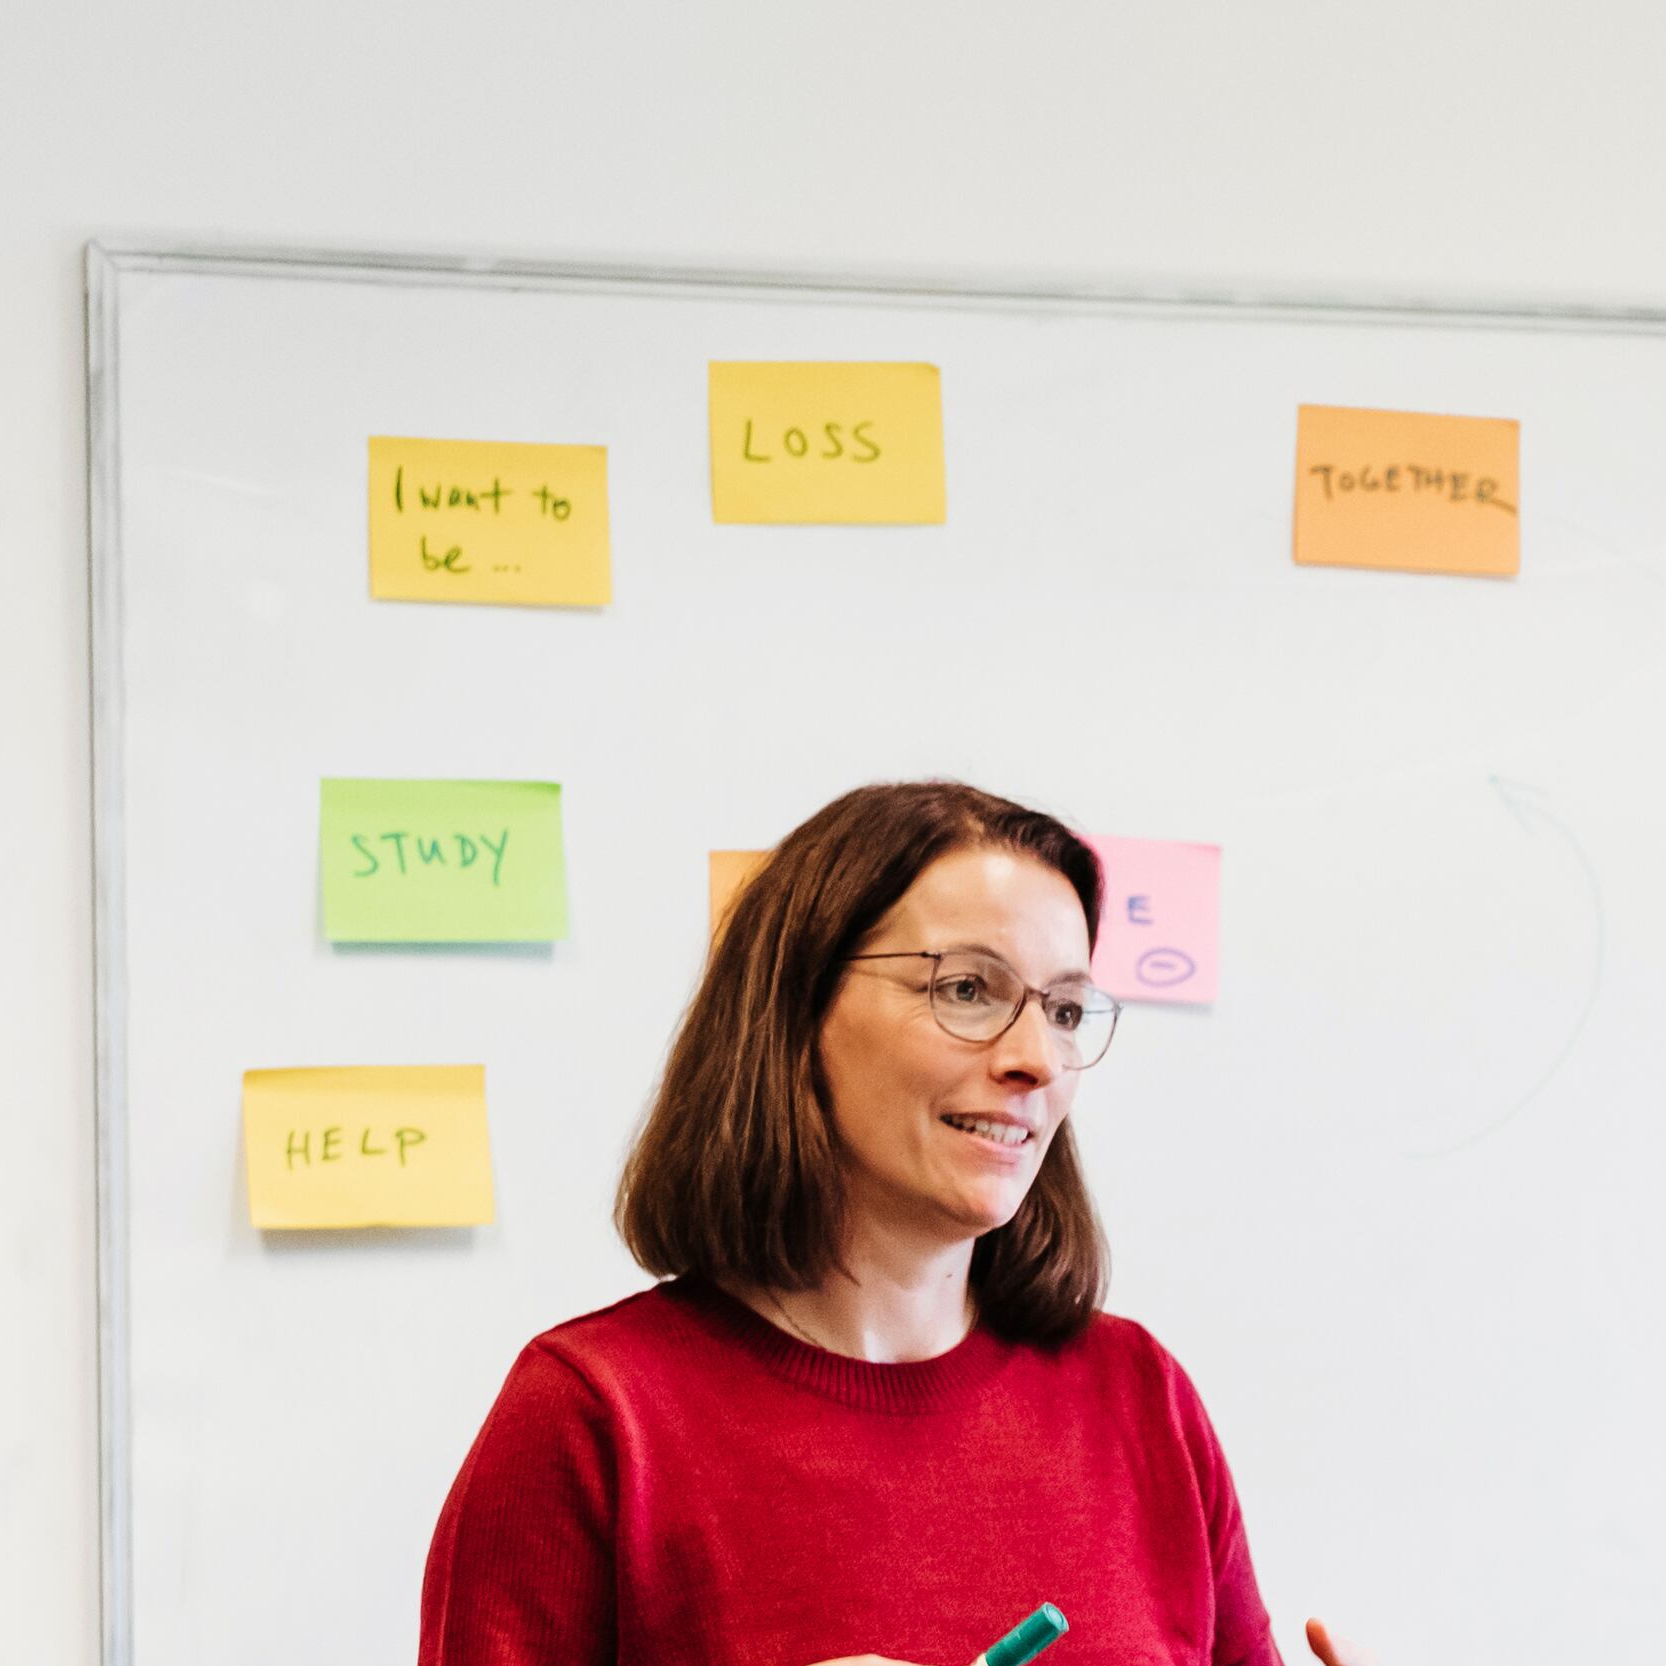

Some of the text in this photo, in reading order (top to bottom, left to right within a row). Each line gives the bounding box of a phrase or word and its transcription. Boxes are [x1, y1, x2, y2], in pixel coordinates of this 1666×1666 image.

[741, 417, 884, 465] LOSS
[393, 465, 573, 523] I want to
[1308, 463, 1517, 515] TOGETHER
[349, 829, 510, 887] STUDY
[284, 1124, 429, 1171] HELP
